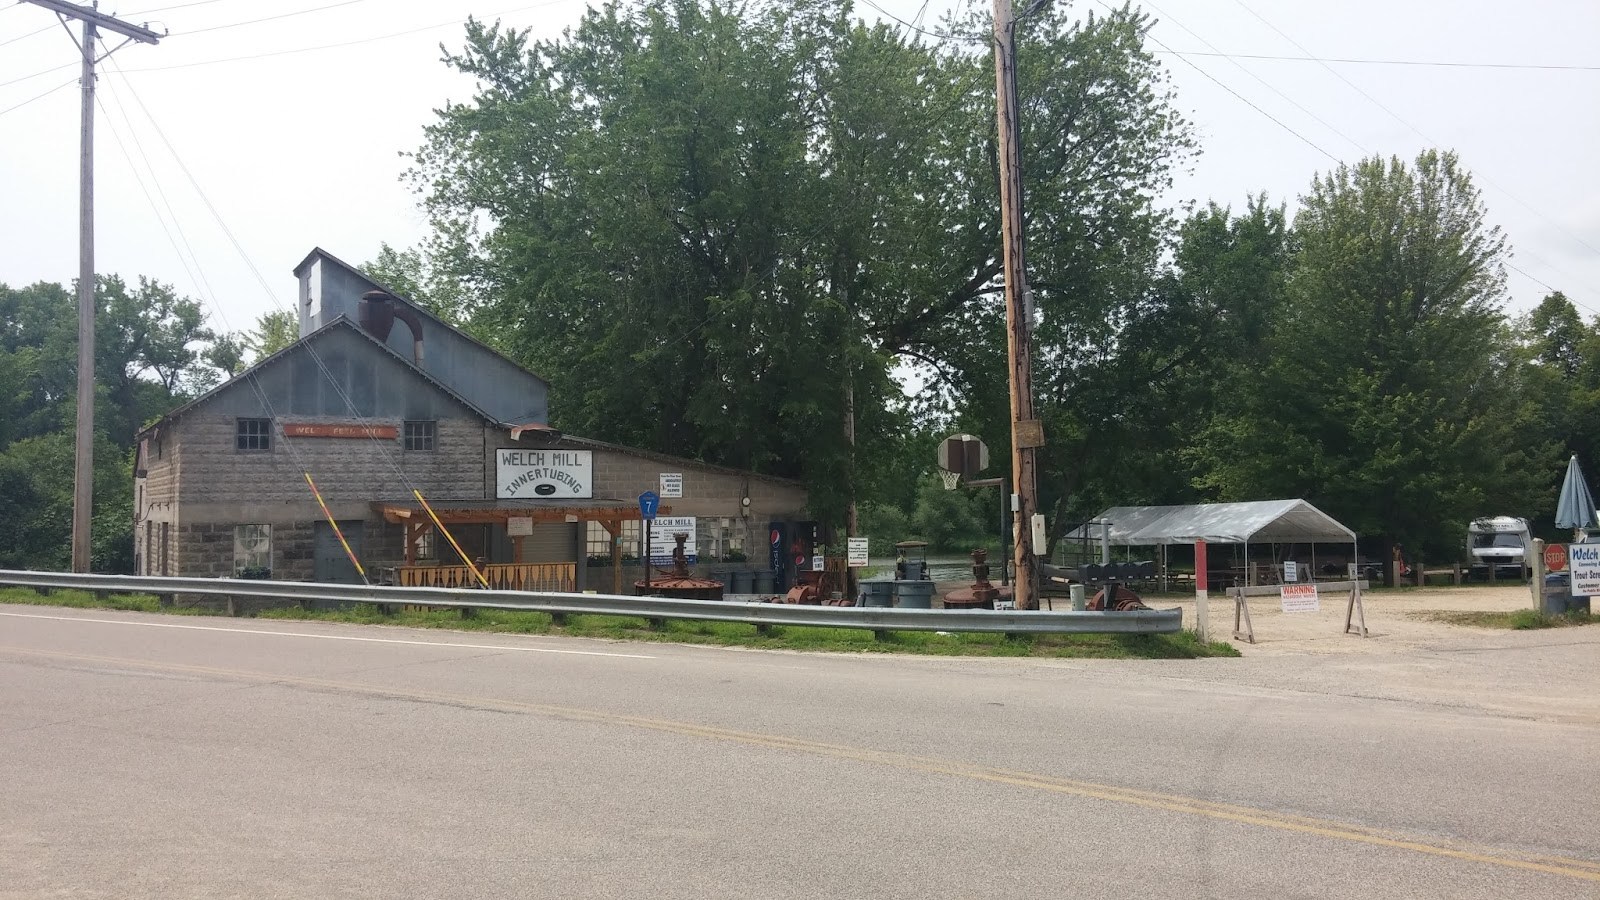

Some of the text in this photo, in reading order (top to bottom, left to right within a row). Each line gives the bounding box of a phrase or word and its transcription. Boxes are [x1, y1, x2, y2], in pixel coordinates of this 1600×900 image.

[502, 452, 582, 467] WELCH MILL
[505, 467, 582, 496] INNERTUBING
[646, 501, 652, 513] 7
[1547, 553, 1565, 562] STOP
[1573, 547, 1599, 560] Welch
[1574, 570, 1588, 579] Trout
[1283, 585, 1315, 594] WARNING
